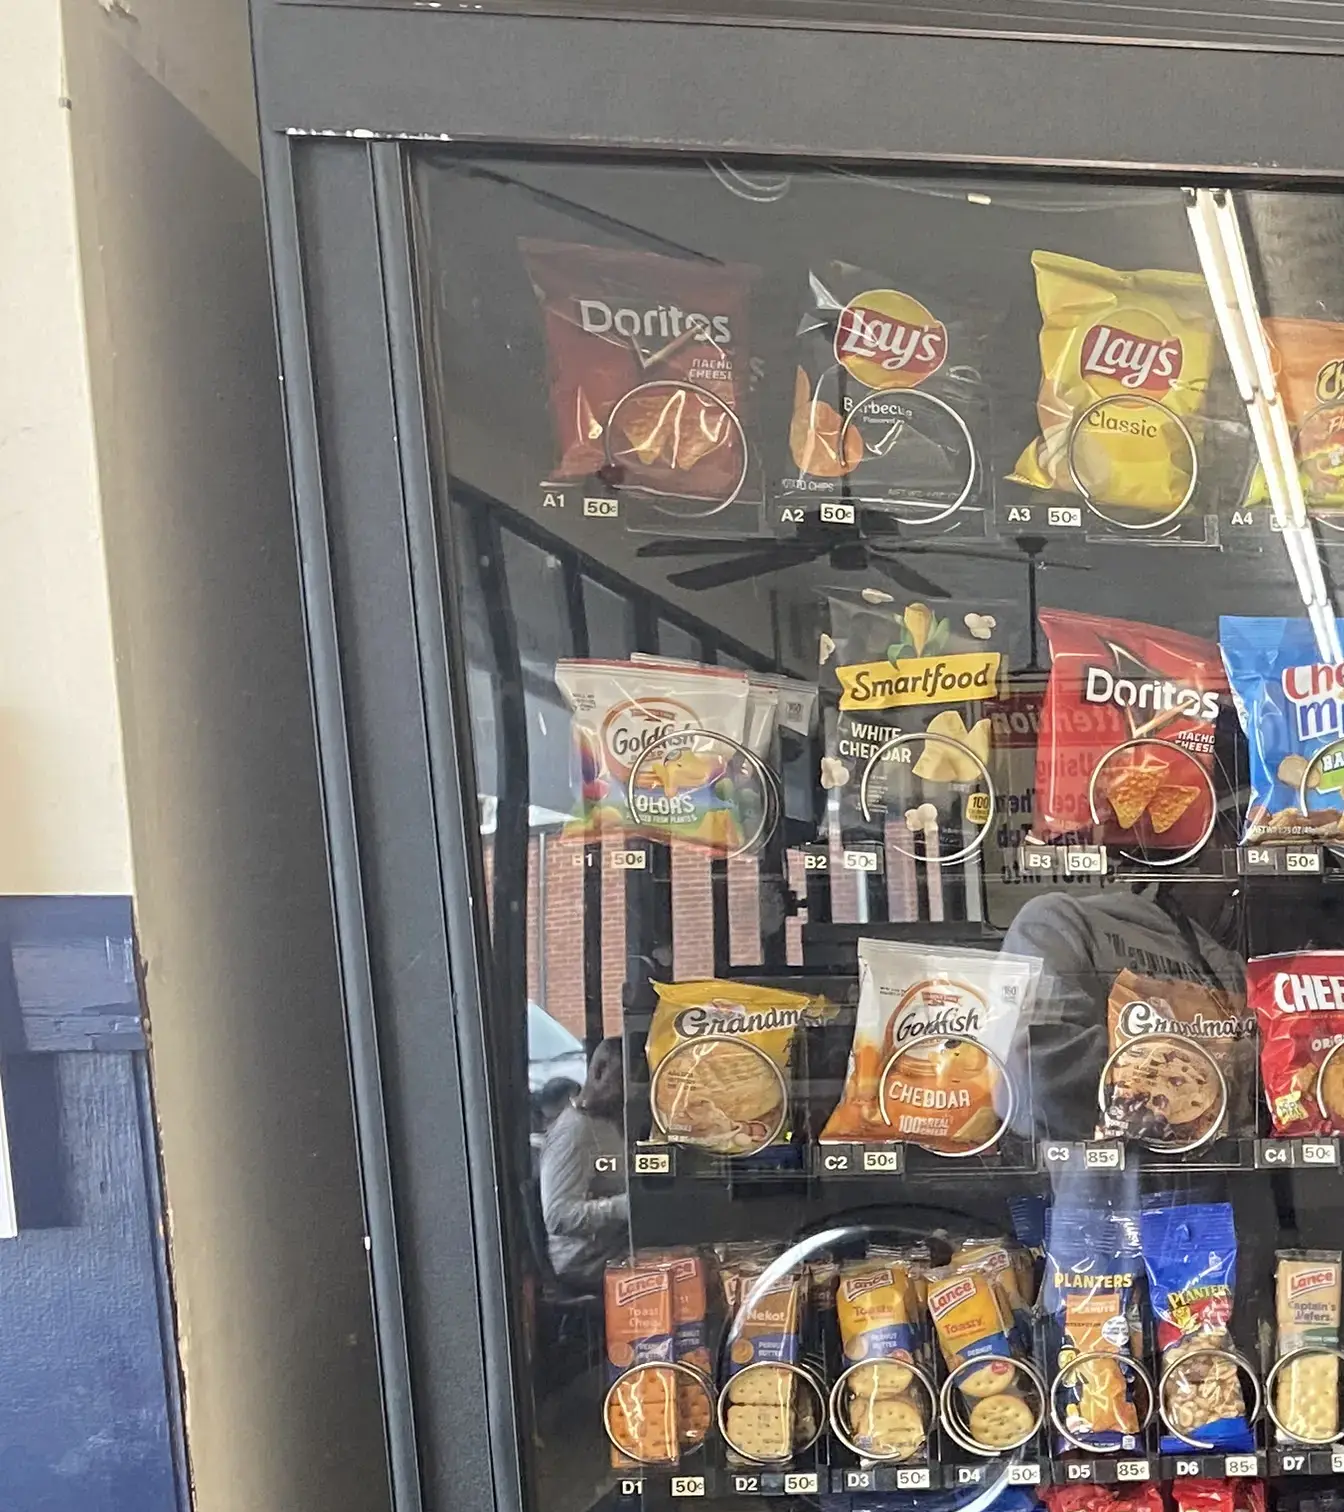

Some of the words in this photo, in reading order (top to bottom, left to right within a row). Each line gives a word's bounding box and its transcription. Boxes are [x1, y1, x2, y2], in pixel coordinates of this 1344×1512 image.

[580, 299, 731, 343] Doritos
[842, 309, 942, 367] Lay's
[1085, 327, 1180, 388] Lay's
[1087, 409, 1158, 438] Classic
[543, 493, 565, 508] A1
[781, 508, 804, 522] A2
[1008, 507, 1031, 522] A3
[1231, 511, 1253, 526] A4
[851, 663, 990, 701] Smartfood
[1086, 667, 1219, 719] Doritos
[612, 722, 694, 755] Goldfish
[851, 722, 901, 742] WHITE
[1177, 732, 1216, 745] NACHO
[839, 740, 911, 763] CHEDDAR
[804, 855, 827, 868] B2
[1029, 855, 1051, 868] B3
[1247, 850, 1269, 864] B4
[889, 1081, 970, 1109] CHEDDAR
[1047, 1147, 1069, 1161] C3
[1265, 1149, 1287, 1163] C4
[595, 1158, 617, 1171] C1
[824, 1156, 847, 1170] C2
[1054, 1273, 1132, 1288] PLANTERS
[1291, 1272, 1333, 1289] Lance
[932, 1281, 973, 1313] Lance
[747, 1309, 786, 1321] Nekot
[1068, 1464, 1090, 1479] D5
[1176, 1462, 1198, 1476] D6
[1283, 1457, 1304, 1471] D7
[848, 1473, 869, 1487] D3
[958, 1469, 980, 1482] D4
[622, 1480, 643, 1495] D1
[736, 1477, 757, 1491] D2
